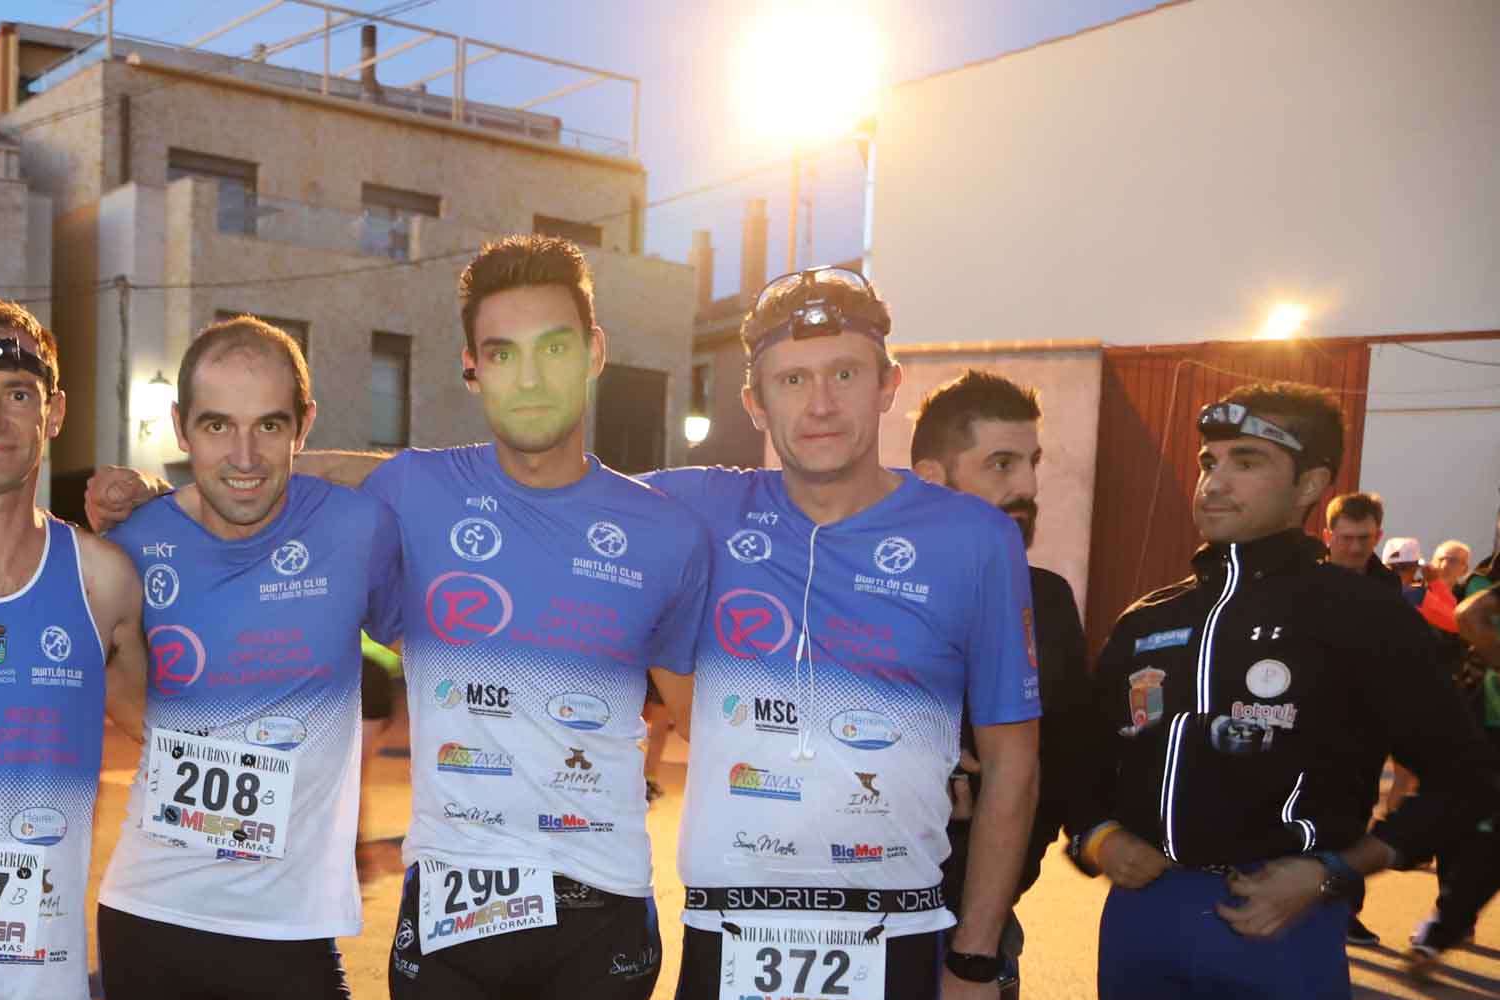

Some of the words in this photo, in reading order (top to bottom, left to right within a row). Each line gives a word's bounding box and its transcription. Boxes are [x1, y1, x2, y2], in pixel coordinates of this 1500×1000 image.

[303, 576, 328, 589] CLUB
[619, 567, 643, 581] CLUB
[902, 581, 929, 594] CLUB
[467, 682, 509, 709] MSC
[755, 697, 798, 725] MSC
[201, 746, 231, 764] CROSS
[173, 761, 261, 817] 208
[152, 803, 276, 844] JOMISAGA
[206, 836, 272, 853] REFORMAS
[831, 843, 883, 859] BigMat
[443, 867, 520, 914] 290
[727, 889, 846, 909] SUNDRIED
[427, 894, 544, 941] JOMISAGA
[477, 915, 544, 936] REFORMAS
[784, 928, 817, 944] CROSS
[818, 929, 880, 945] CABRERIZ
[754, 947, 851, 995] 372
